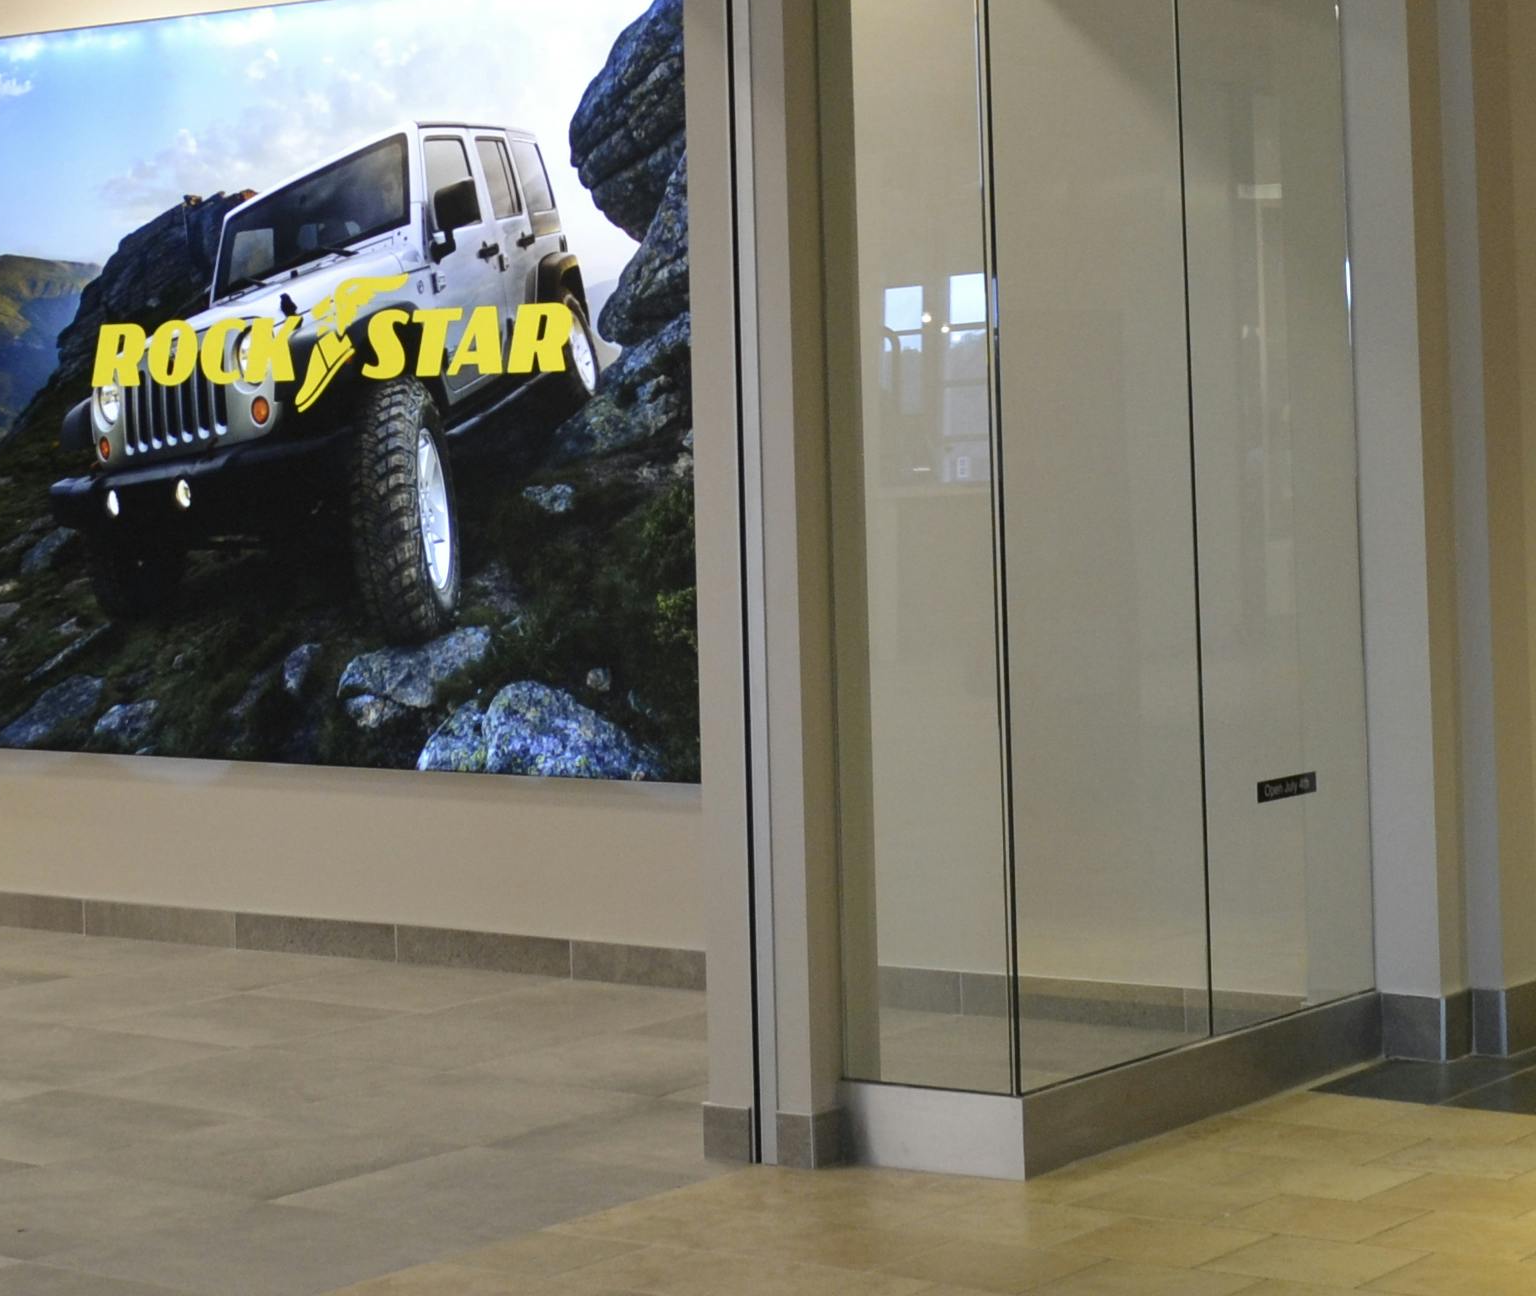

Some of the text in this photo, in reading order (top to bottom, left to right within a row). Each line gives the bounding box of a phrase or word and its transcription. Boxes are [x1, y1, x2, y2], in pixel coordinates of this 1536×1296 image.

[92, 302, 572, 388] ROCK STAR
[1264, 783, 1283, 798] Open
[1284, 779, 1299, 795] July
